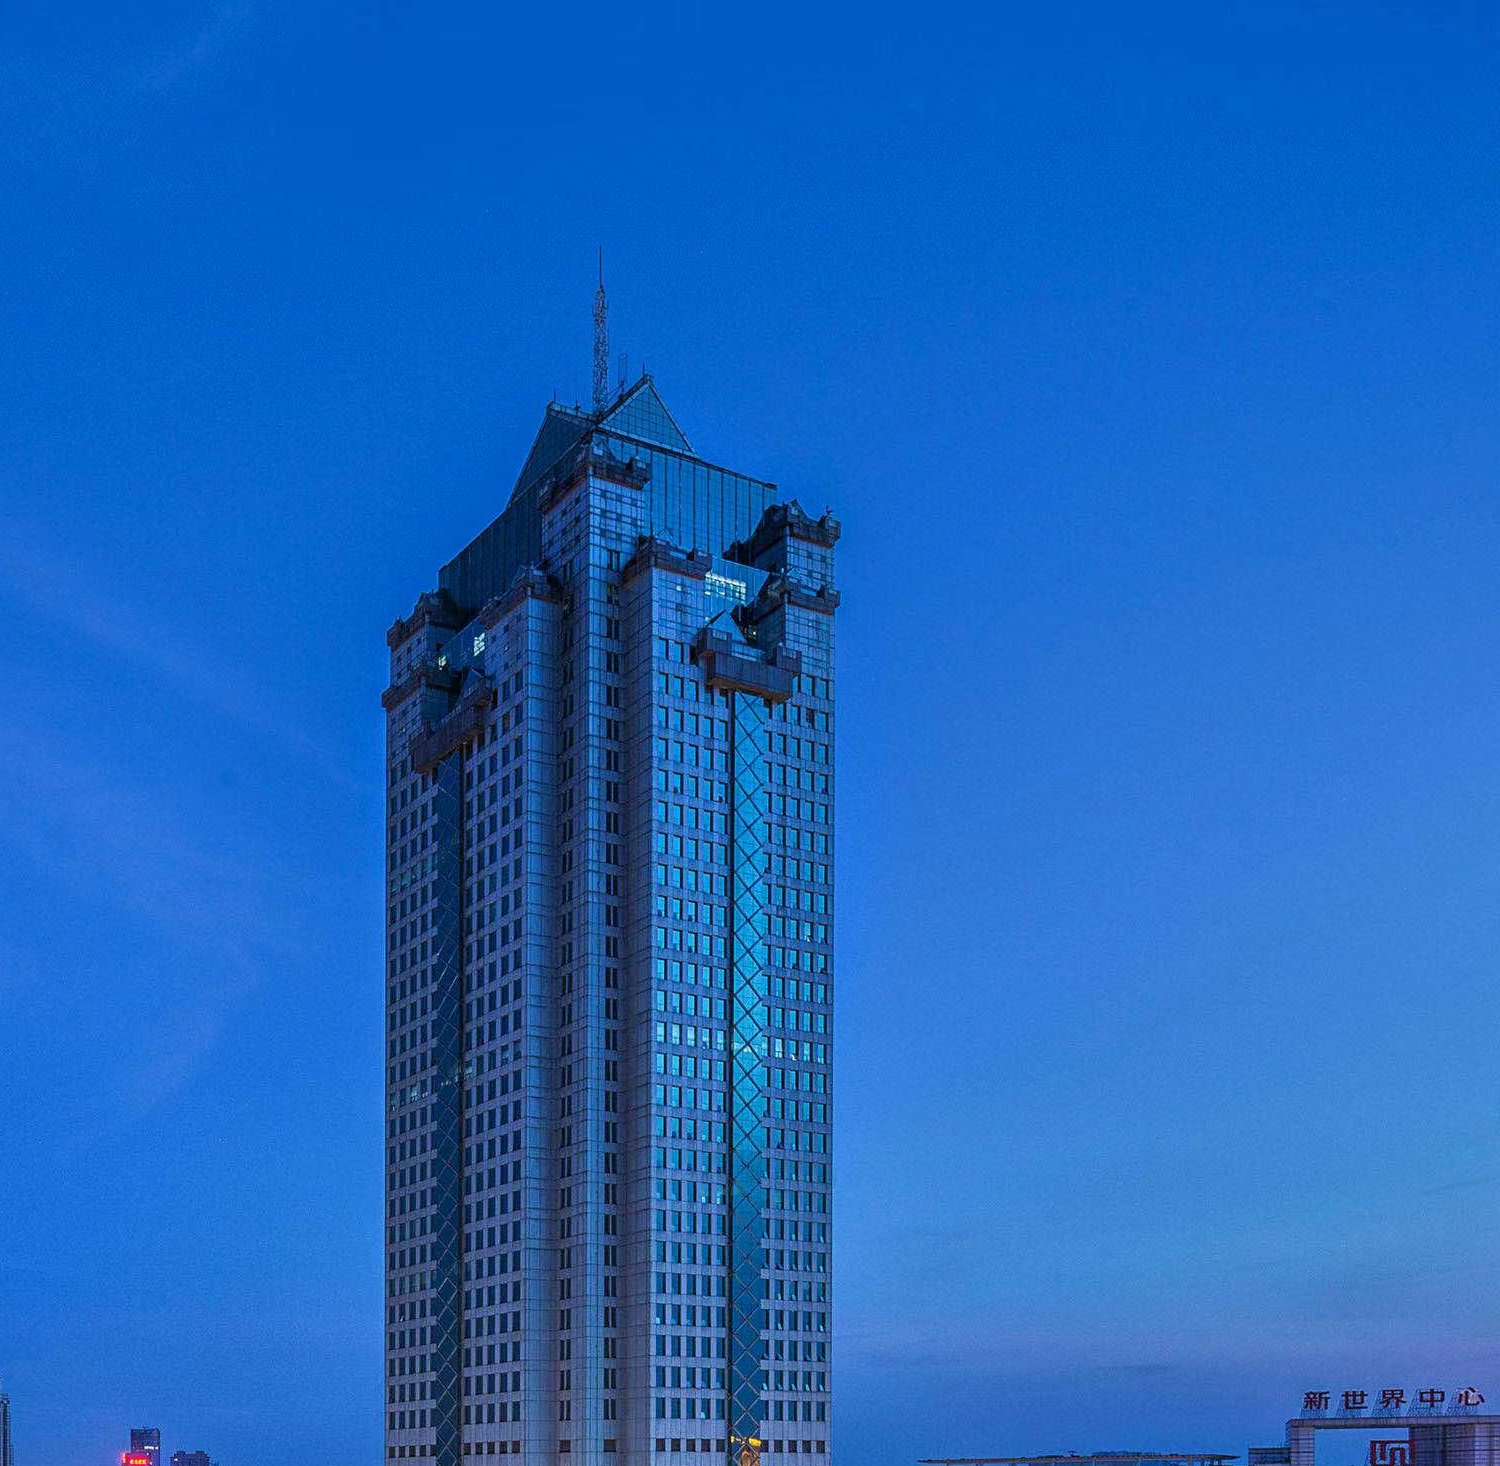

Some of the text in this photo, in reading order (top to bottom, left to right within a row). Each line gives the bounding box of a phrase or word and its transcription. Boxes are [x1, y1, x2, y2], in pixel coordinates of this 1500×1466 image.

[1303, 1387, 1485, 1410] 新世界中心
